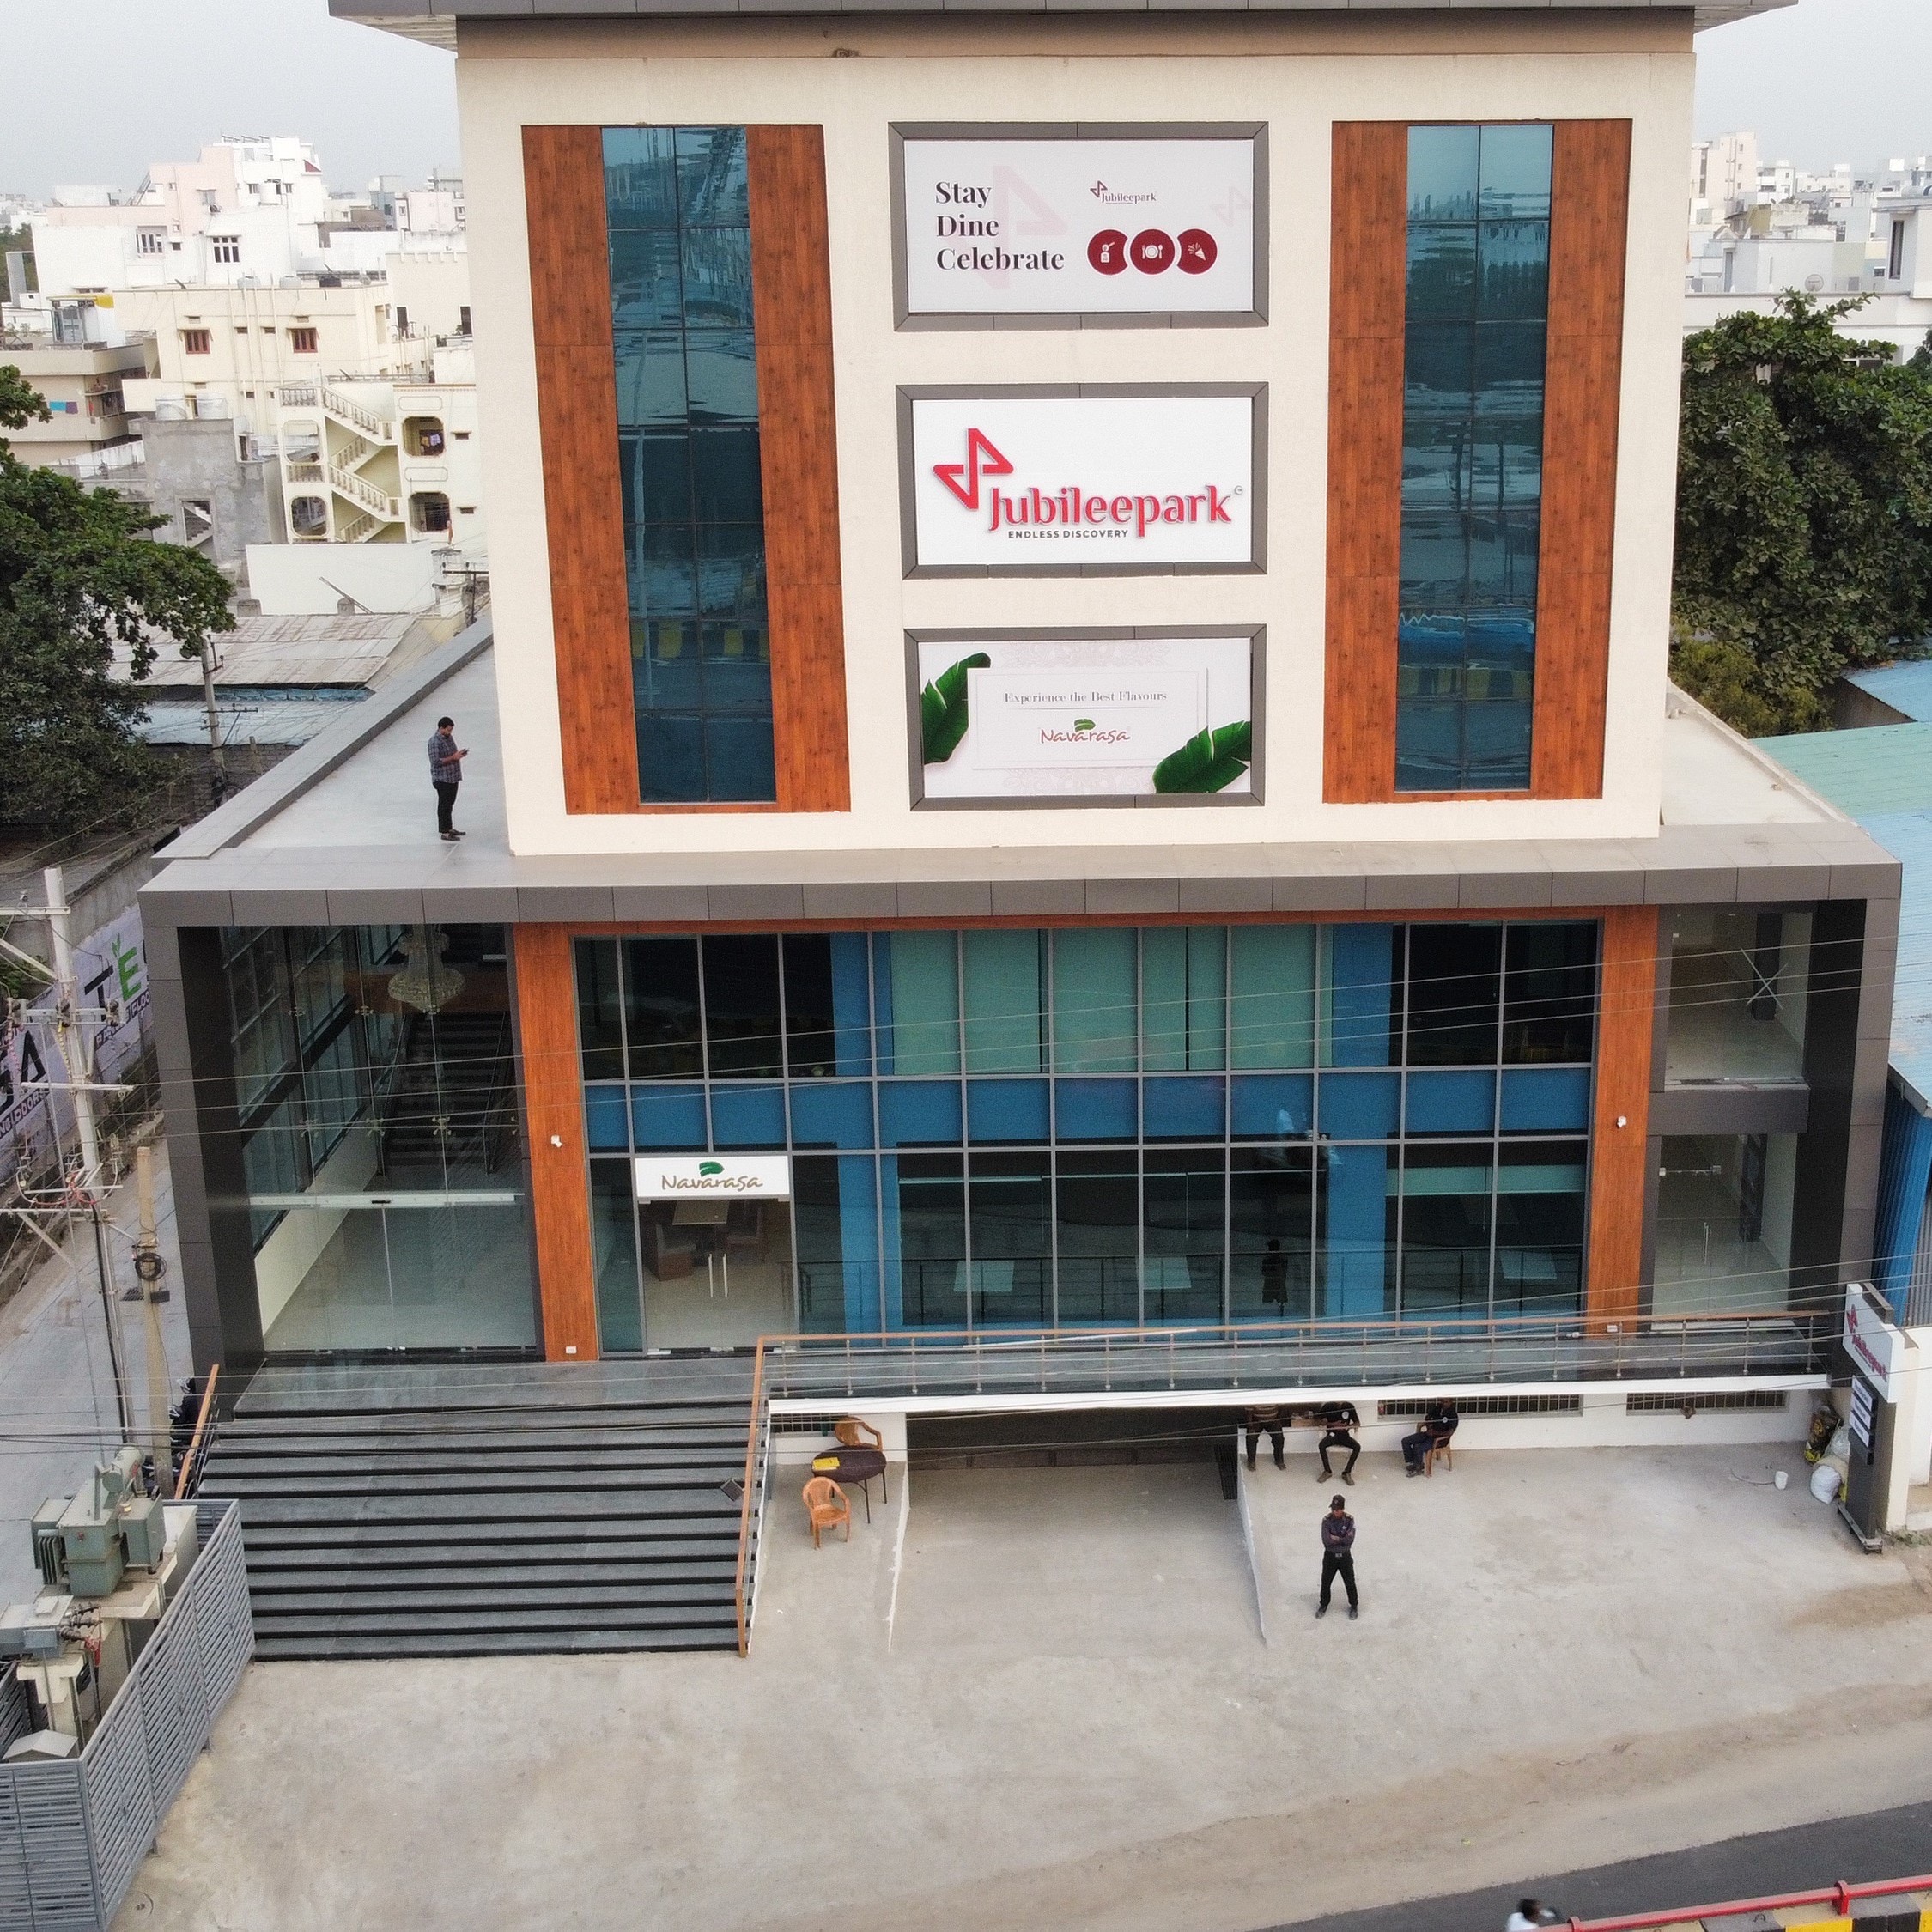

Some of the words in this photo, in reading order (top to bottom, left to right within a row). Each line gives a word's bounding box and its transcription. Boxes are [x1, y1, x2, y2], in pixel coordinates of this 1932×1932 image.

[936, 181, 992, 208] Stay
[1102, 192, 1157, 204] Jubileepark
[936, 214, 999, 236] Dine
[936, 246, 1065, 270] Celebrate
[988, 485, 1232, 538] Jubileepark
[1008, 530, 1060, 539] ENDLESS
[1063, 529, 1128, 538] DISCOVERY
[1005, 692, 1066, 704] Experience
[1070, 691, 1087, 702] the
[1091, 691, 1115, 702] Best
[1119, 690, 1167, 702] Flavours
[1041, 728, 1131, 744] Navarasa
[661, 1174, 763, 1191] Navarasa
